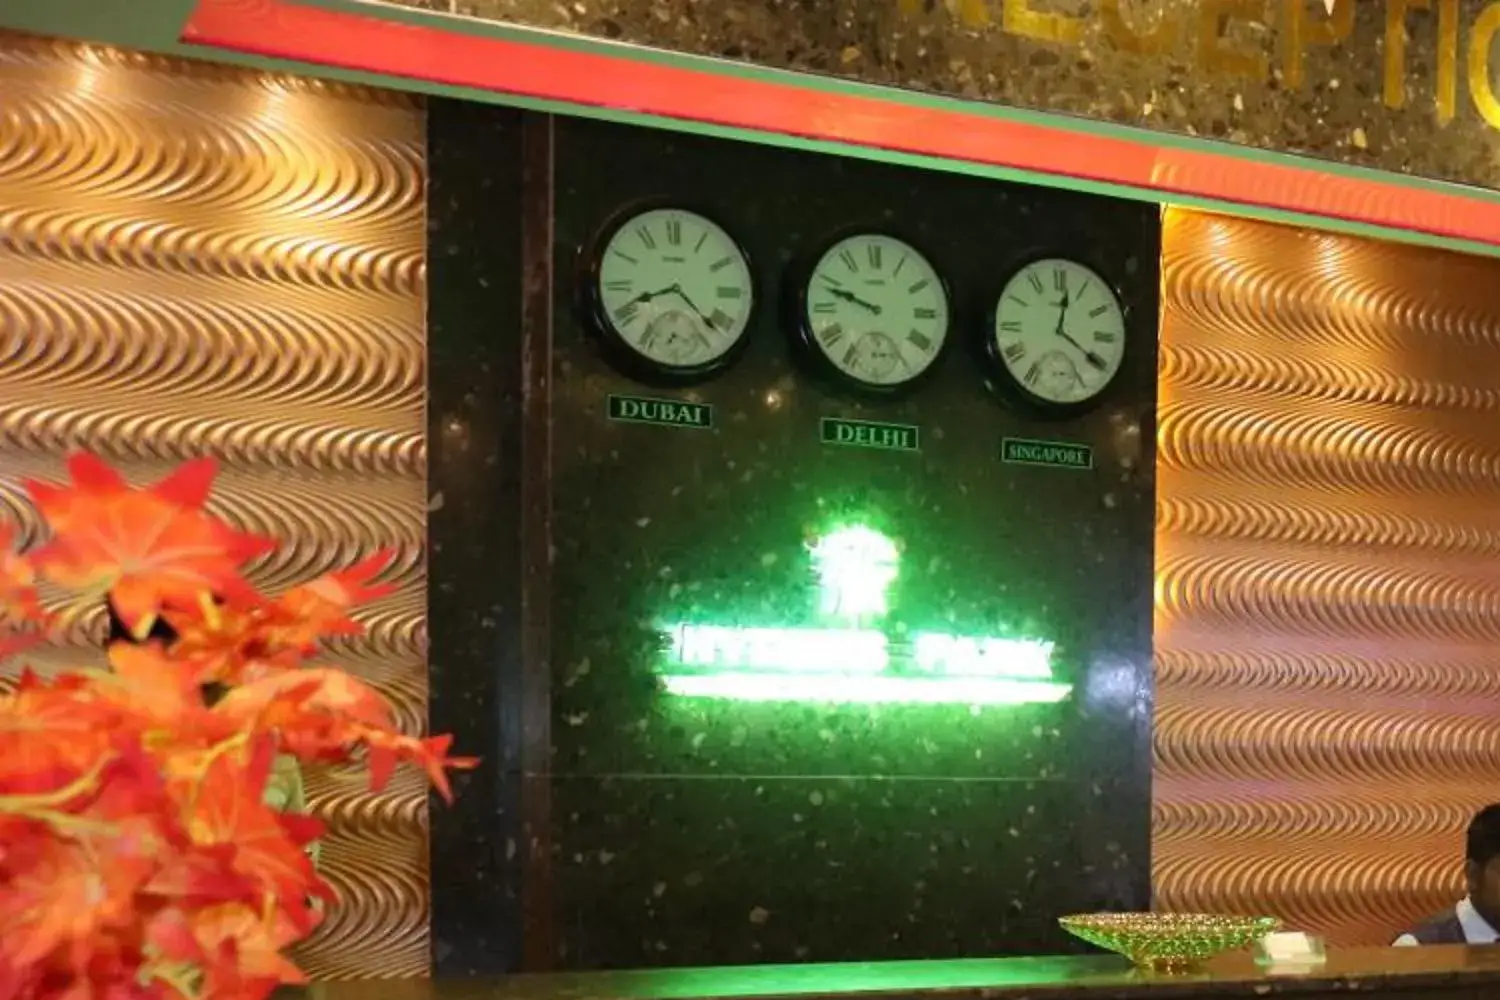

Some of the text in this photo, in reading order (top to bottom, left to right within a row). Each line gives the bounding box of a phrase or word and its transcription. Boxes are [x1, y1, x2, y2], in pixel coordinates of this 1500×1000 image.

[618, 401, 702, 424] DUBAI
[836, 420, 910, 448] DELHI
[1009, 443, 1086, 466] SINGAPORE
